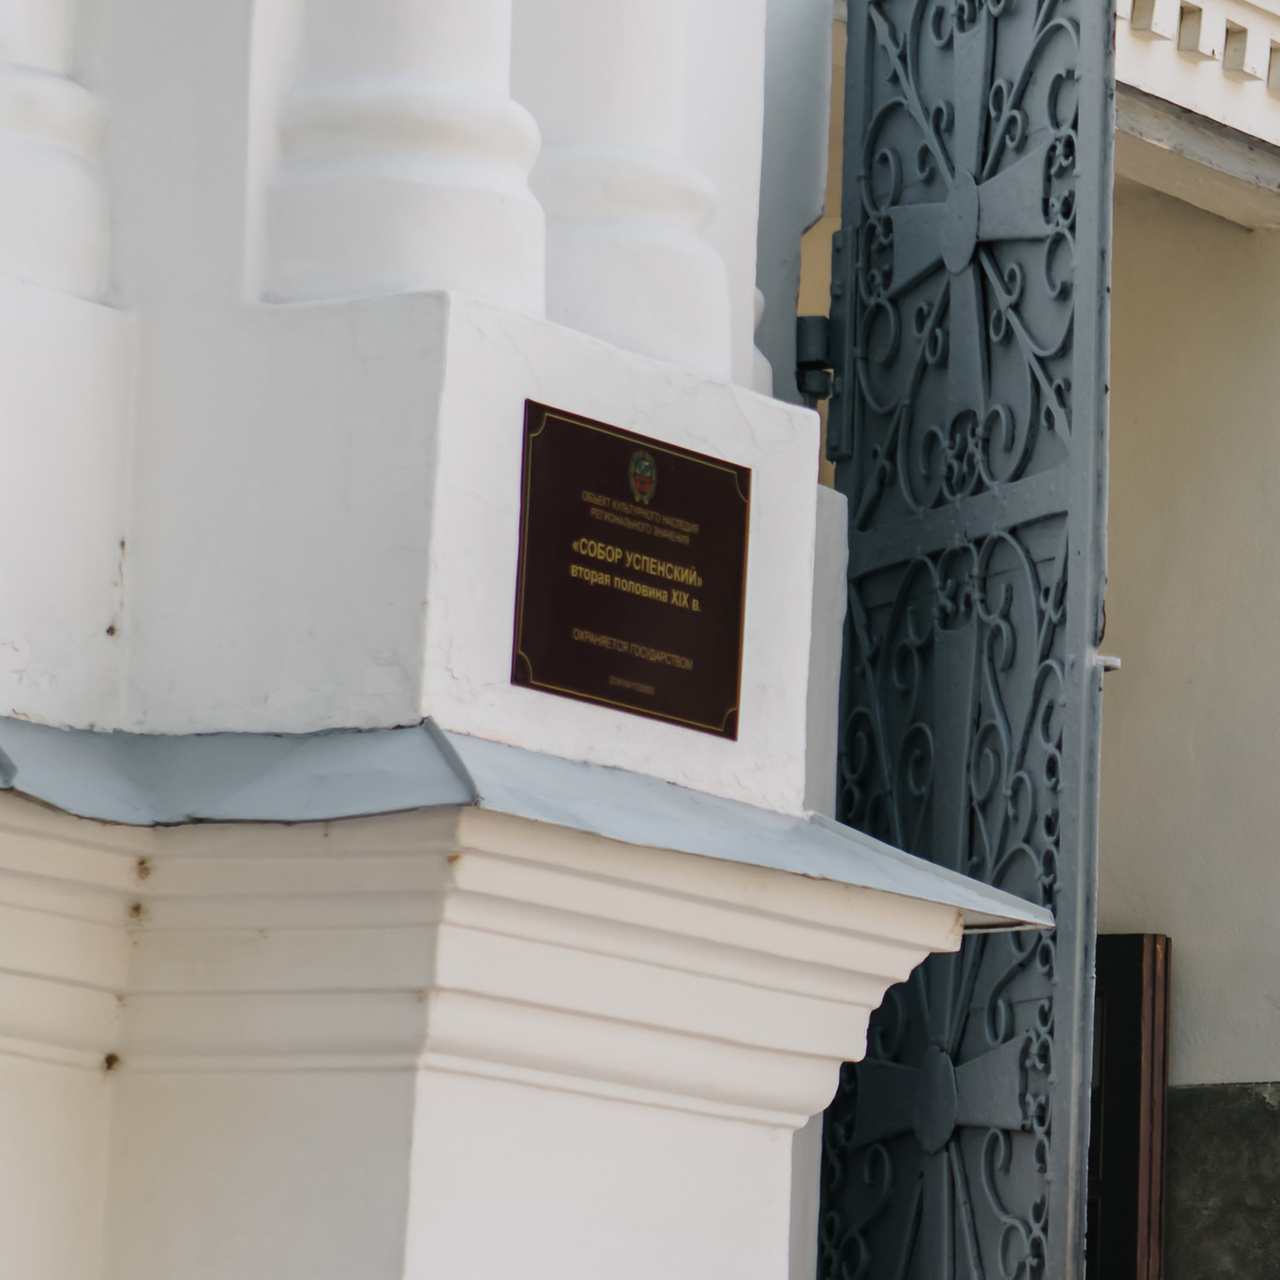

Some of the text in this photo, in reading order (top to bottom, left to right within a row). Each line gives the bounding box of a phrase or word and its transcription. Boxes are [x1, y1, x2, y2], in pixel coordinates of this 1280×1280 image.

[572, 537, 703, 587] «СОБОР УСПЕНСКИЙ»
[570, 564, 702, 612] вторая половина XIX в.
[572, 628, 693, 670] ОХРАНЯЕТСЯ ГОСУДАРСТВОМ
